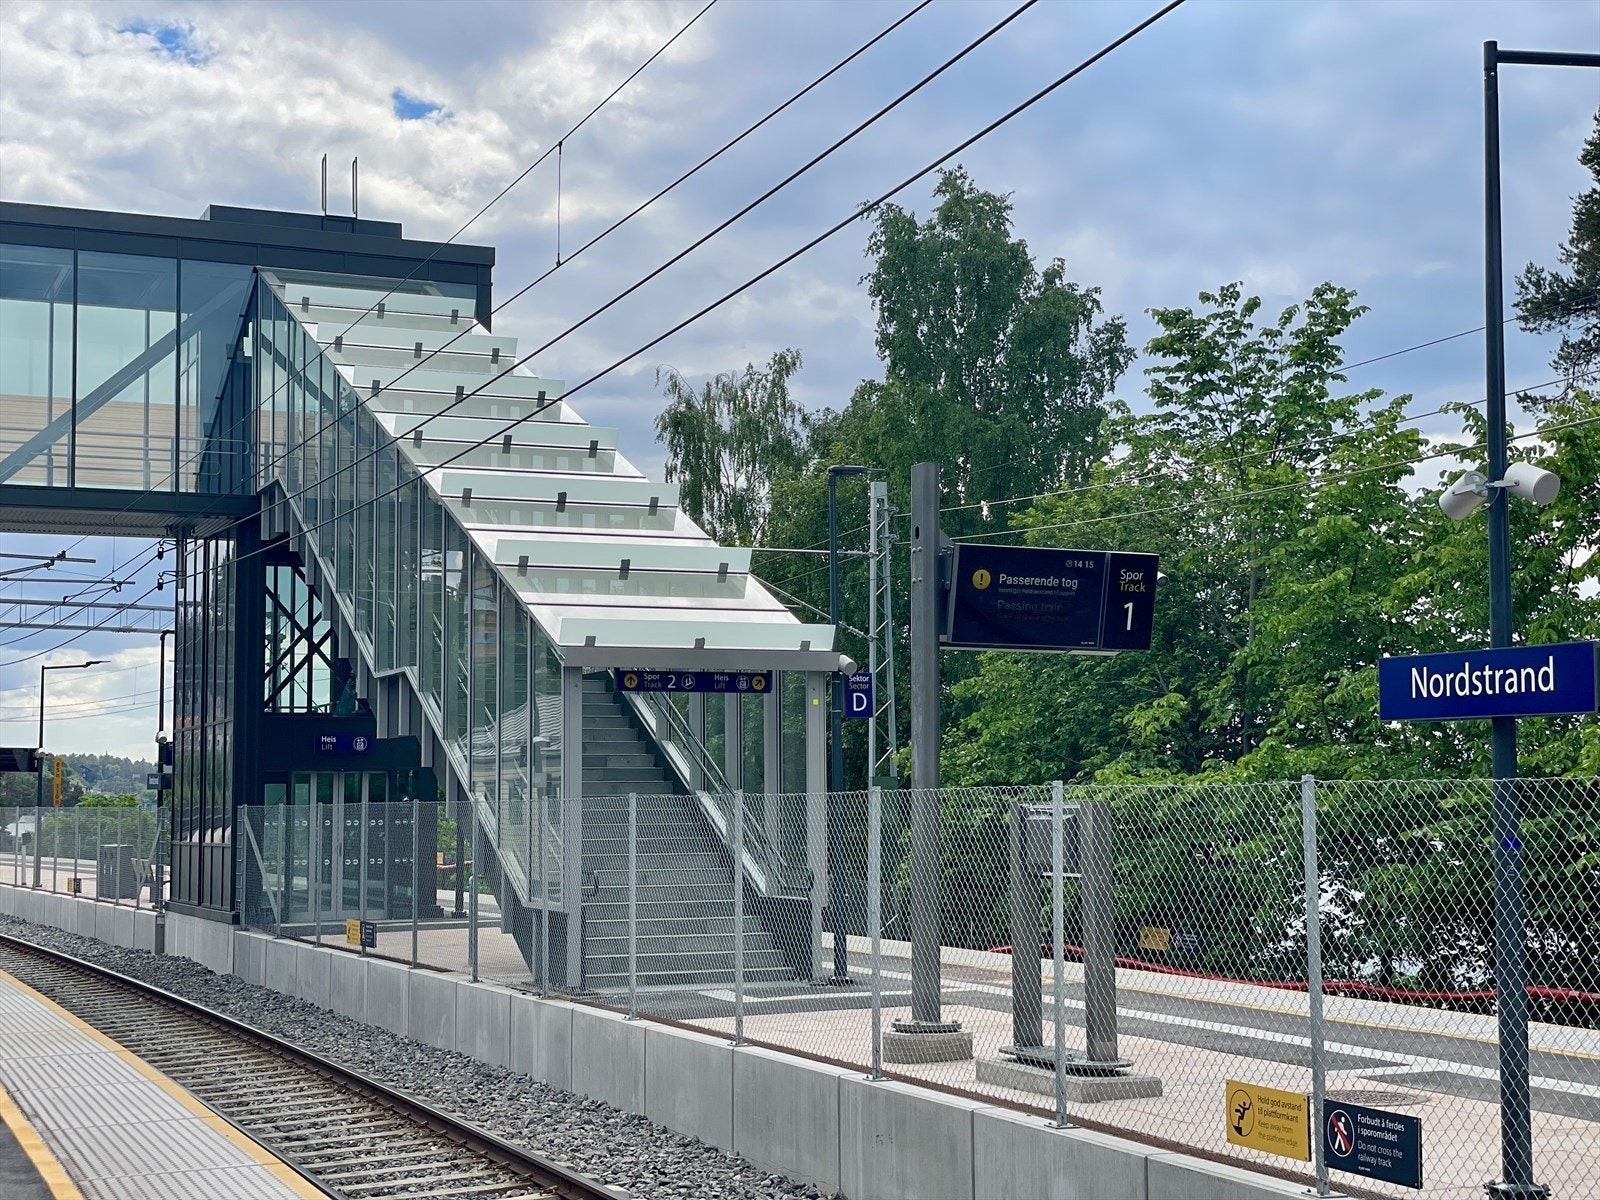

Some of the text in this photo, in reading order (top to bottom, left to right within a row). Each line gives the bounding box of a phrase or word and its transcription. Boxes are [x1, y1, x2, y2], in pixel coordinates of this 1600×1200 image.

[999, 573, 1079, 590] Passerende tog
[1120, 569, 1143, 582] Spor
[1119, 580, 1146, 593] Track
[997, 599, 1064, 614] Passing train
[1123, 602, 1133, 631] 1
[643, 673, 660, 681] Spor
[667, 674, 677, 689] 2
[714, 674, 729, 682] Heis
[848, 674, 870, 682] Sektor
[1411, 655, 1555, 699] Nordstrand
[644, 681, 662, 689] Track
[714, 682, 725, 690] Lift
[849, 682, 870, 690] Sector
[853, 692, 867, 712] D
[321, 735, 337, 743] Heis
[321, 743, 333, 751] Lift
[1257, 1094, 1302, 1112] Hold god avstand
[1263, 1108, 1299, 1124] plattformkant
[1357, 1113, 1405, 1132] Forbudt å ferdes
[1270, 1123, 1281, 1133] away
[1357, 1125, 1398, 1142] i sporområdet
[1357, 1140, 1403, 1159] Do not cross the
[1357, 1153, 1393, 1168] railway track
